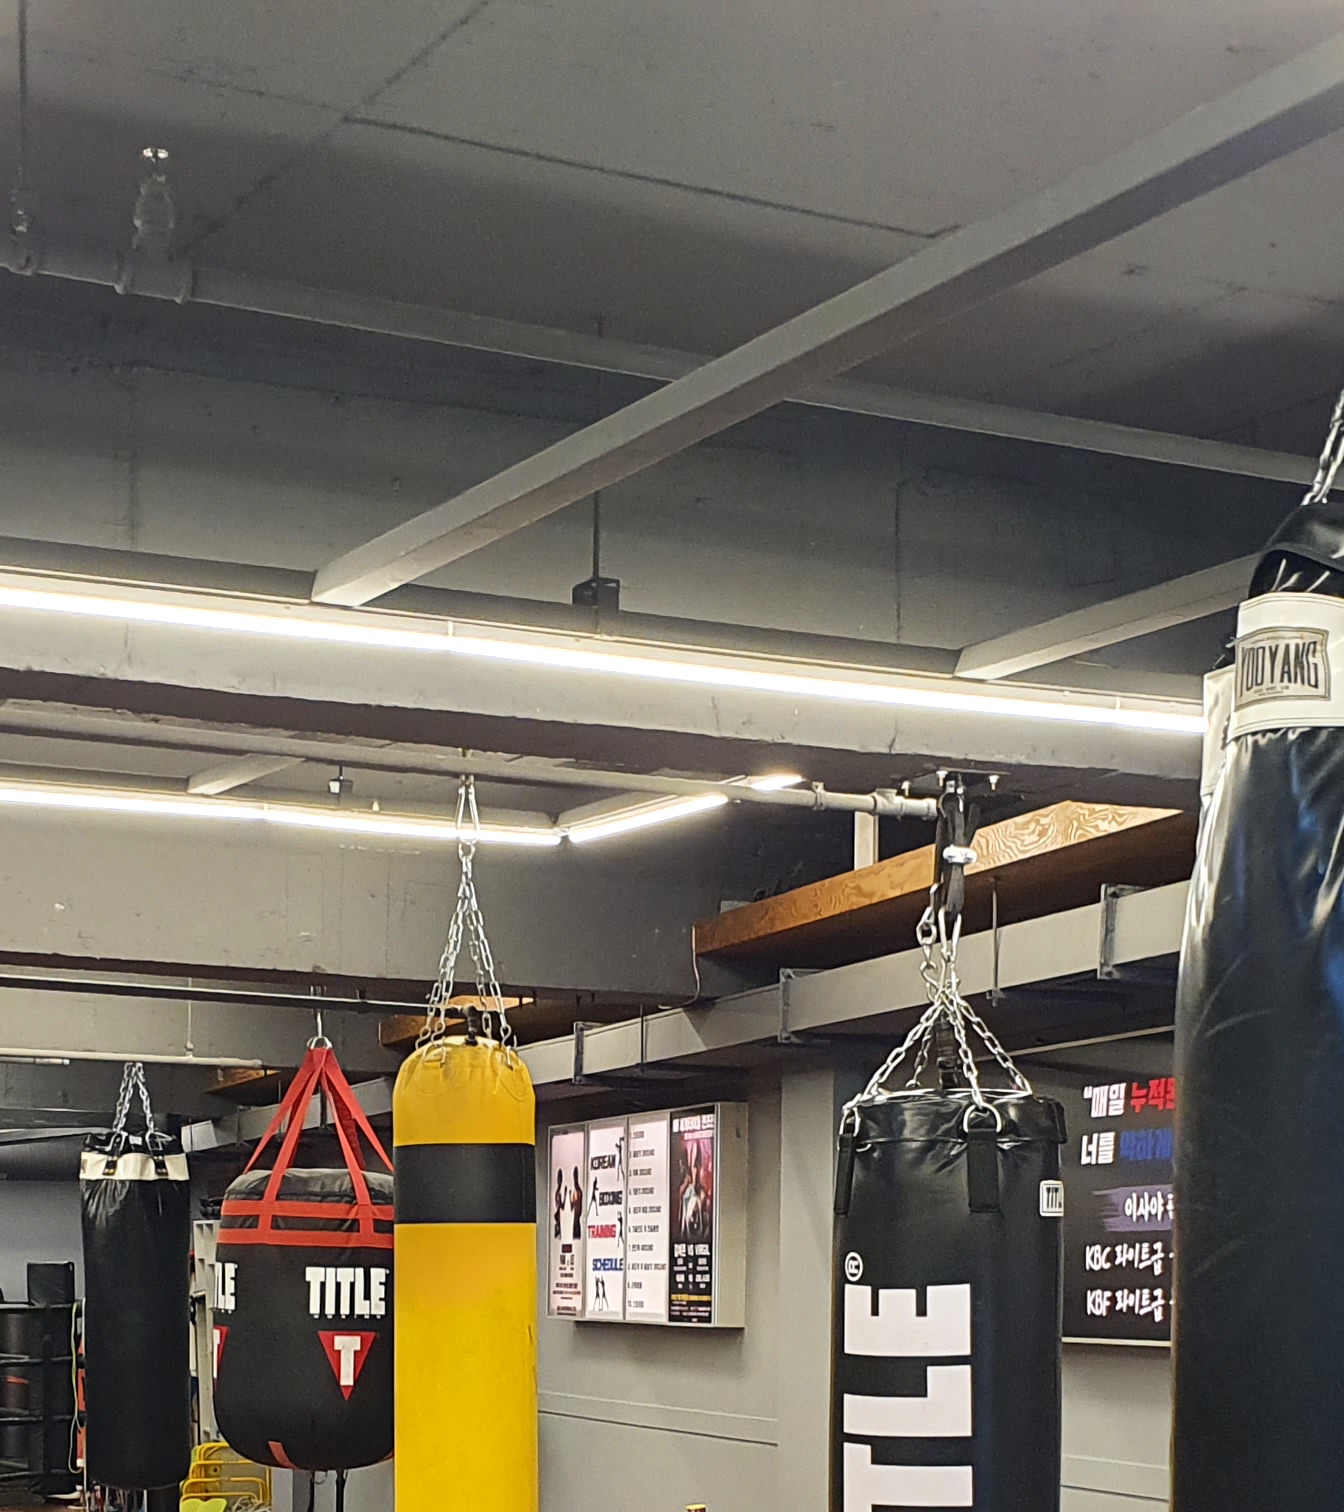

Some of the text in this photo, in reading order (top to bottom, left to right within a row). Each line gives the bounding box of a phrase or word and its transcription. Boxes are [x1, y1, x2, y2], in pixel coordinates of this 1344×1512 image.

[1240, 641, 1318, 697] YOOYANG
[1081, 1132, 1115, 1165] 너를
[1124, 1190, 1164, 1222] 이사야
[592, 1258, 623, 1271] SCHEDULE
[1086, 1244, 1111, 1270] KBC
[306, 1267, 386, 1315] TITLE
[1087, 1289, 1112, 1317] KBF
[334, 1335, 361, 1386] T
